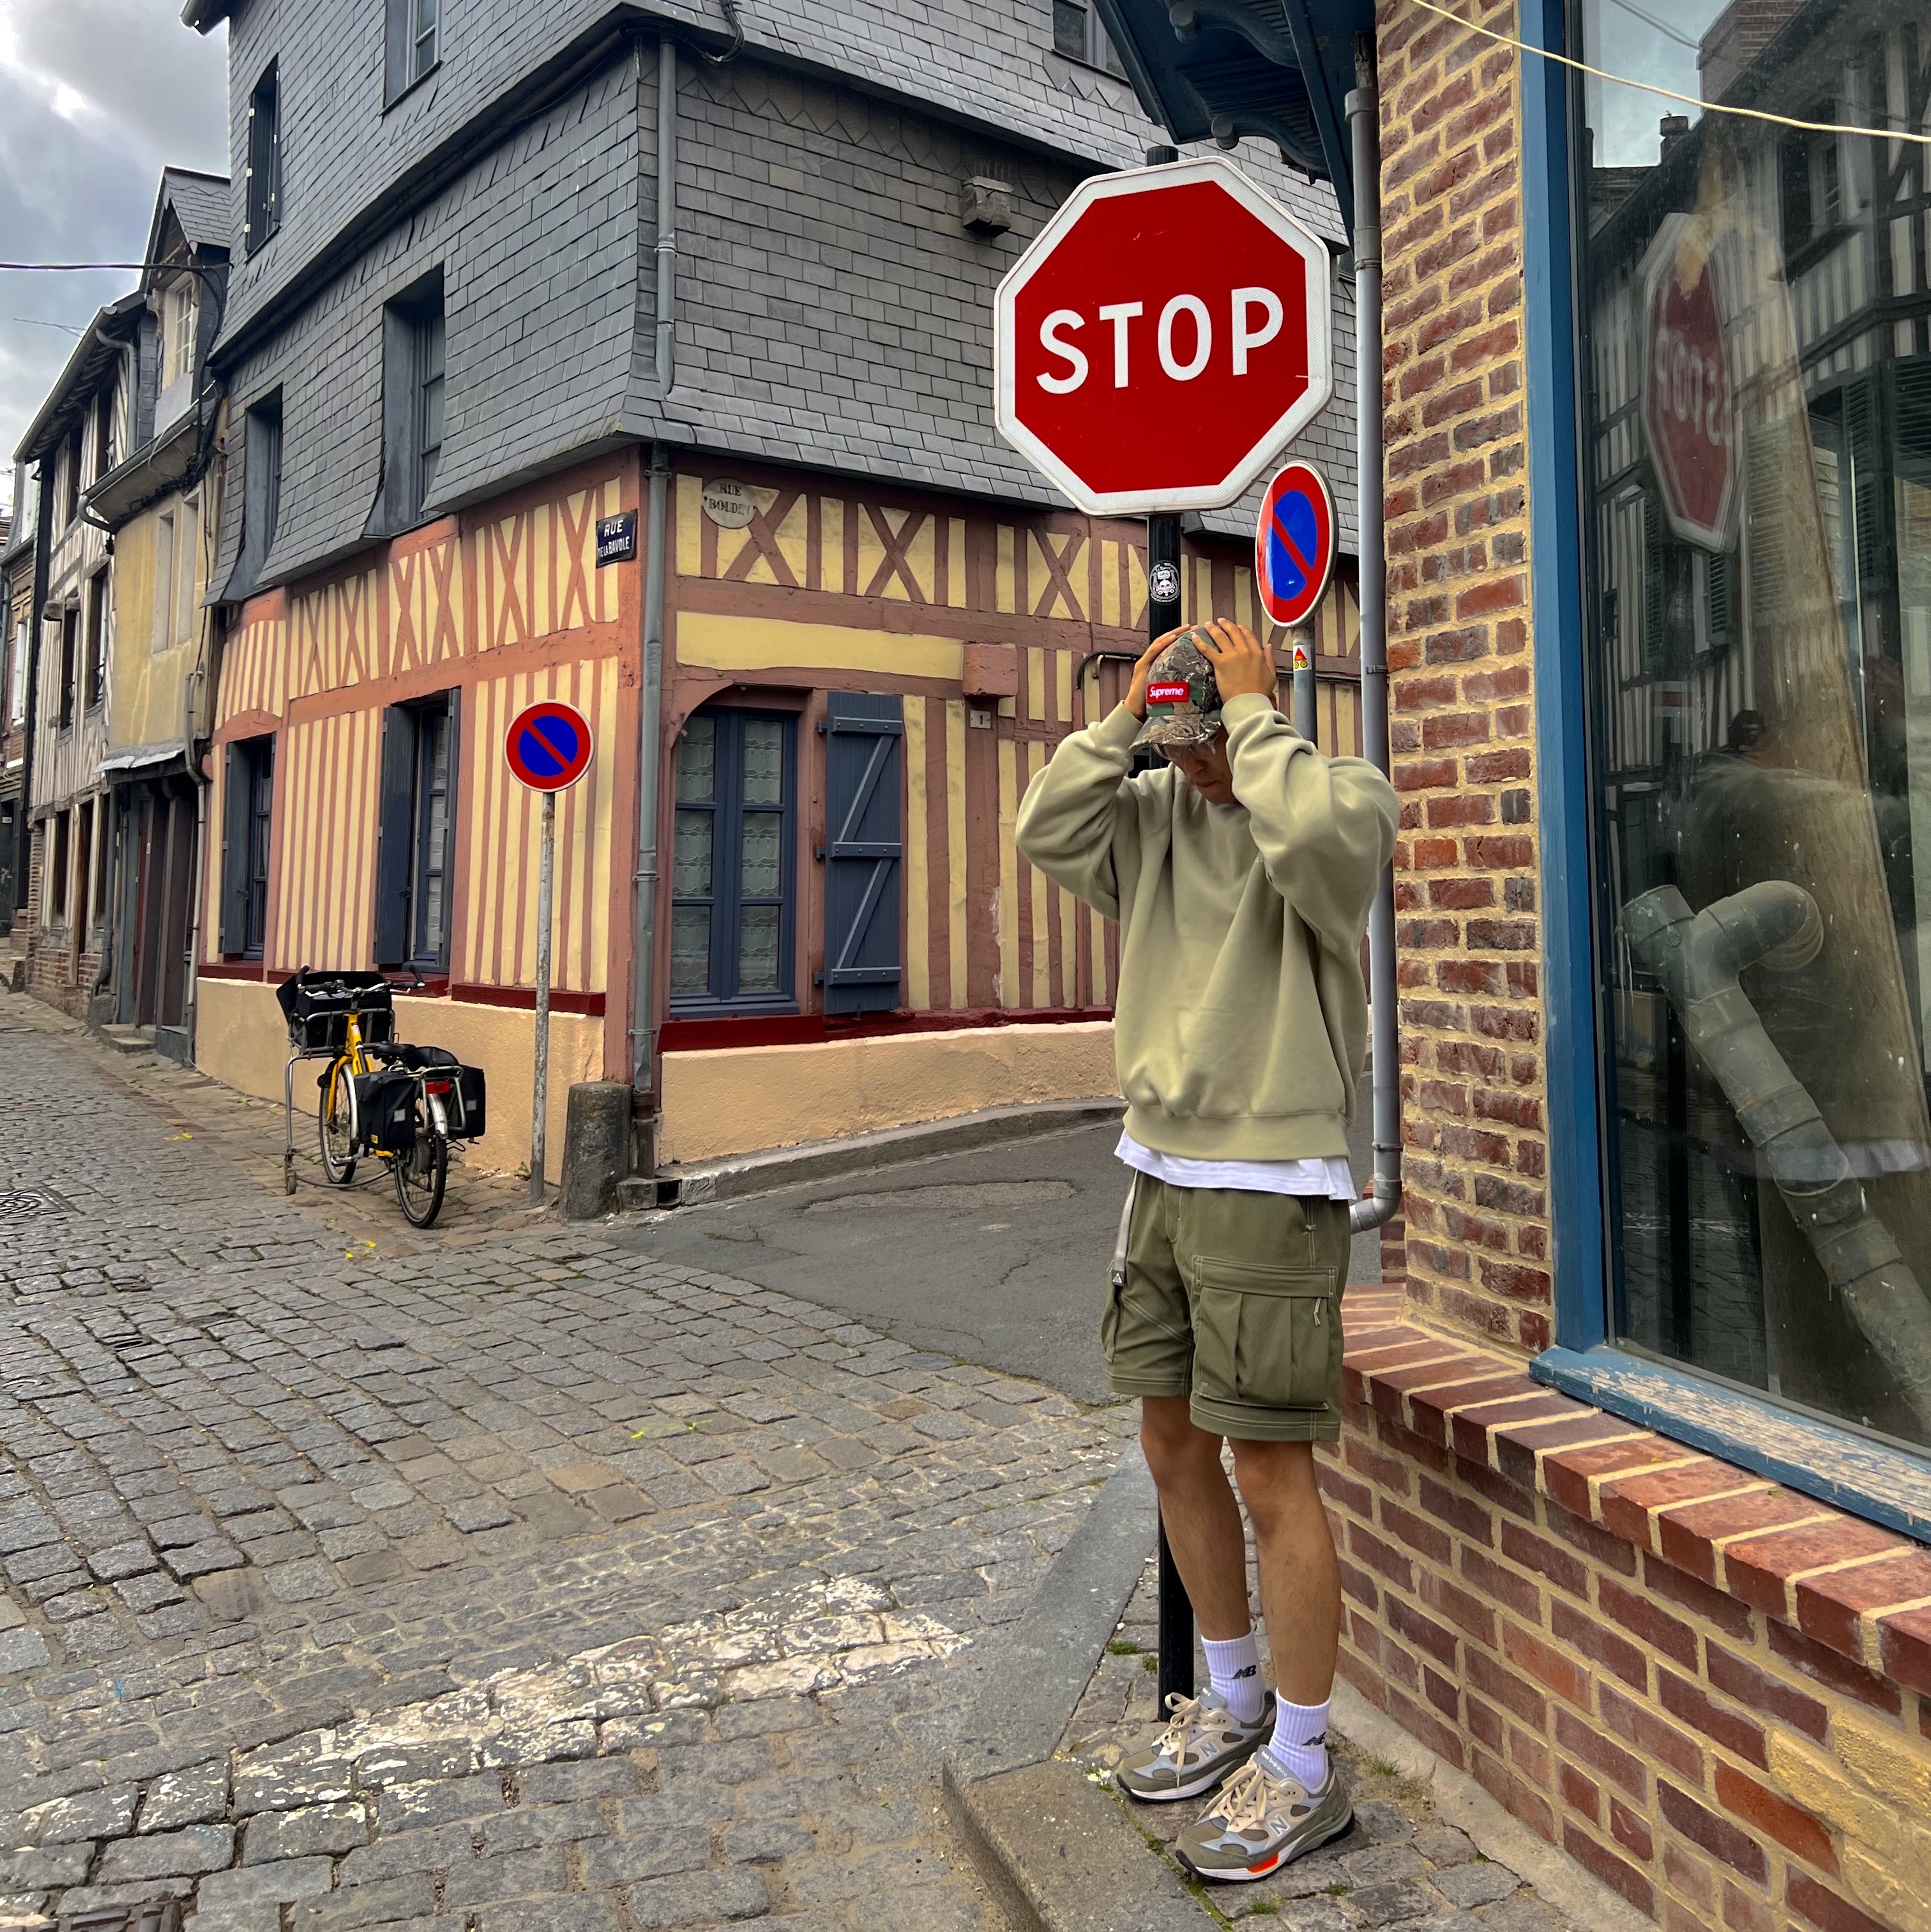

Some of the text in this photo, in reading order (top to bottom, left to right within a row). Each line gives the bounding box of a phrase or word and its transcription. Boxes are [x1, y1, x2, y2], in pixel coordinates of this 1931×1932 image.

[1036, 286, 1284, 395] STOP
[719, 483, 741, 496] RUE
[604, 519, 624, 537] RUE
[608, 536, 630, 554] BAVOLE
[1149, 686, 1185, 699] Supreme
[1268, 1756, 1288, 1777] balance
[1267, 1813, 1290, 1837] N
